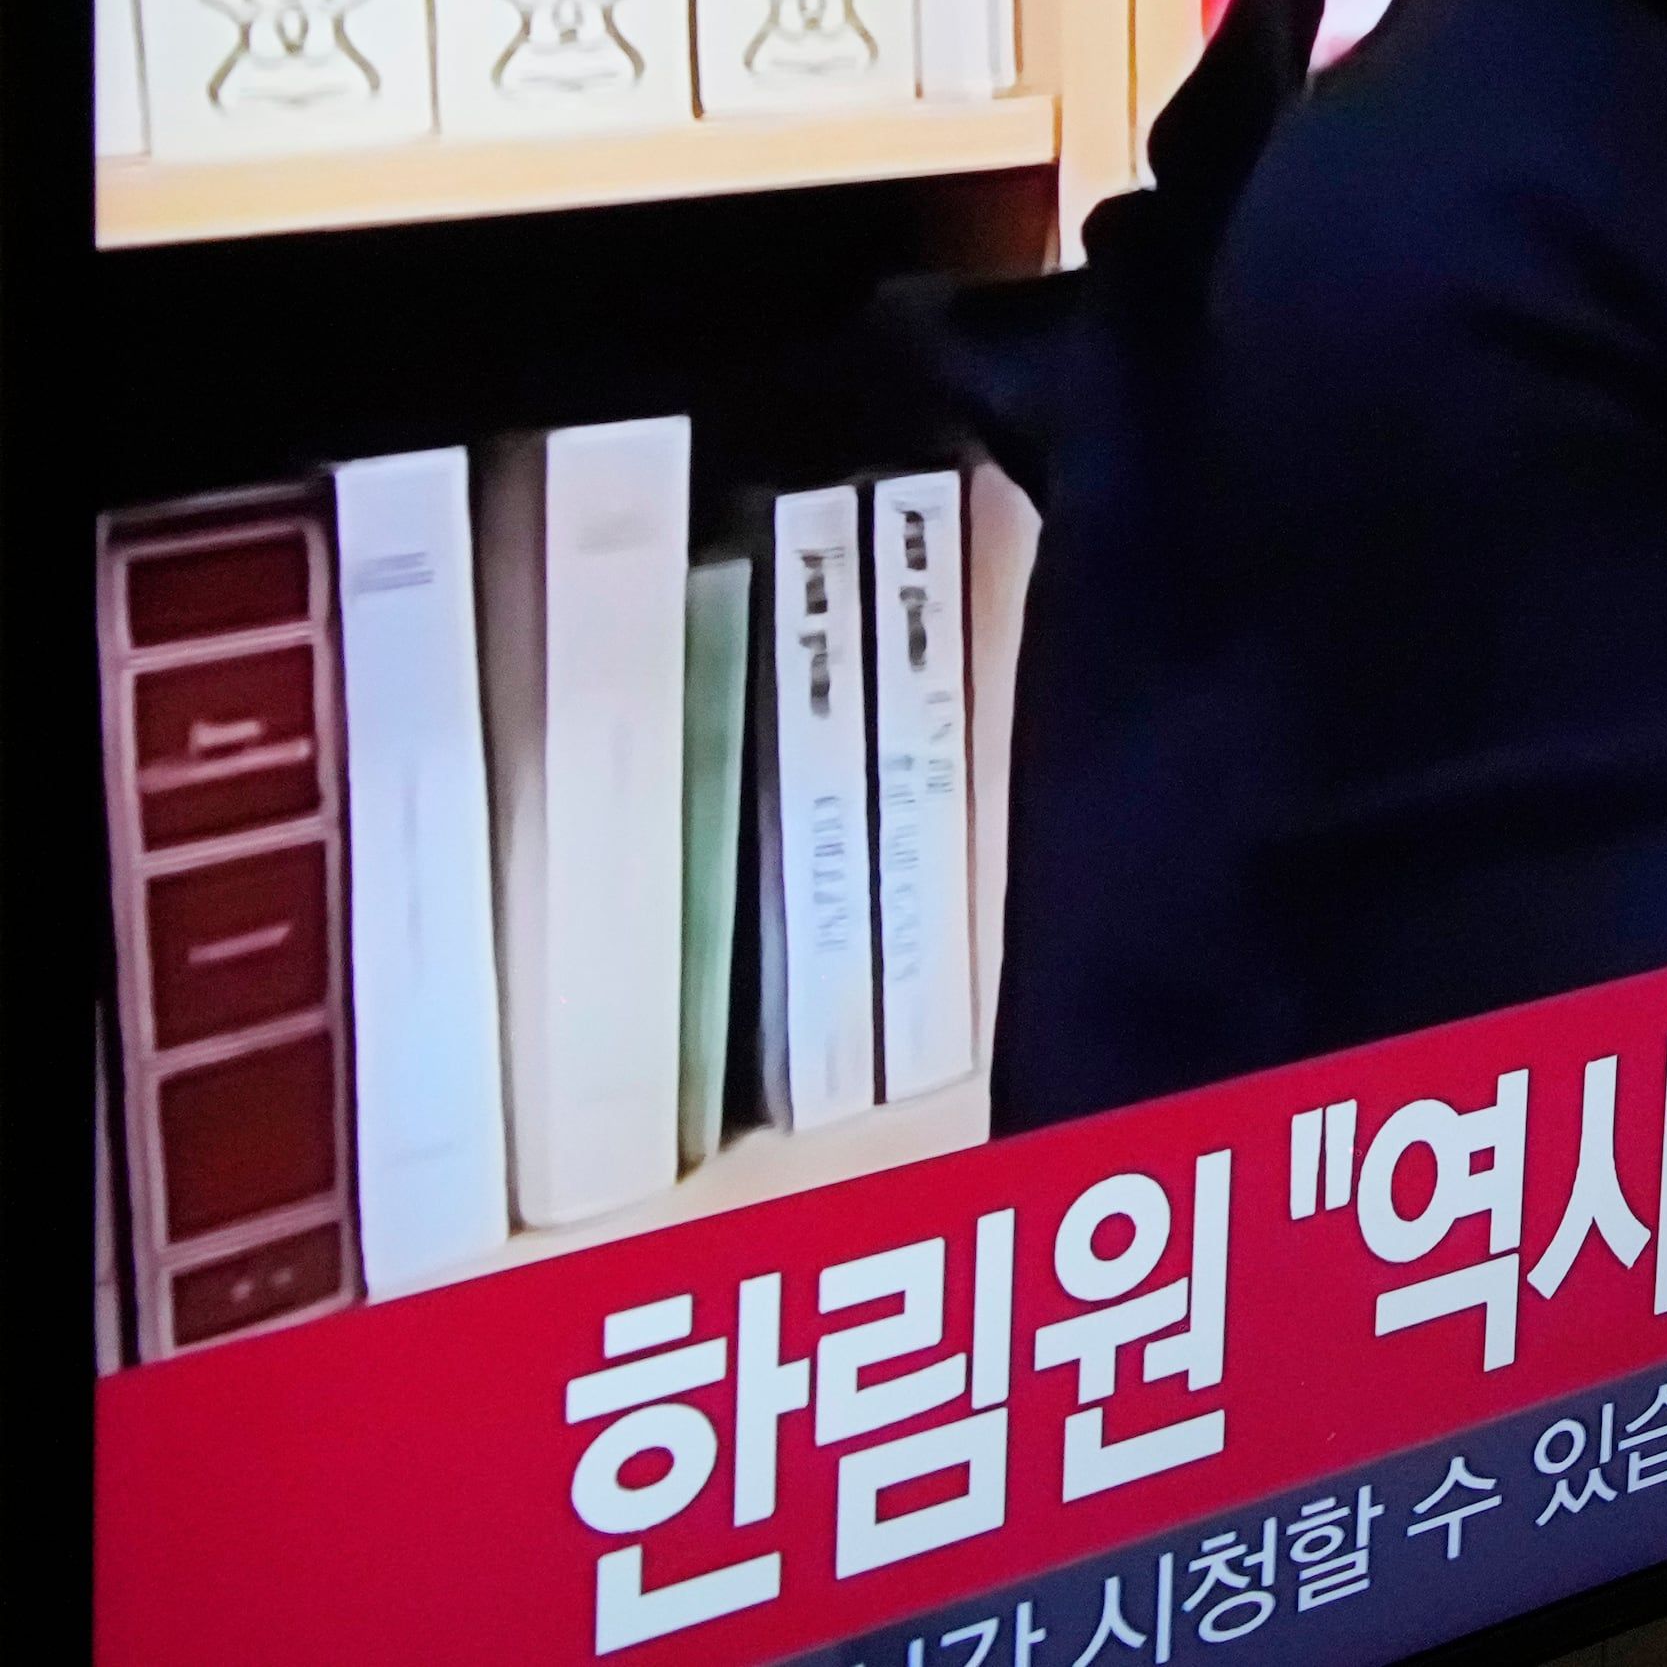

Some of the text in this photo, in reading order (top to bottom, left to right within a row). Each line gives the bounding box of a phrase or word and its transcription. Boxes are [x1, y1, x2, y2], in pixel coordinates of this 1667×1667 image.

[565, 1149, 1233, 1657] 한림원
[1076, 1484, 1386, 1666] 시청할
[1406, 1455, 1503, 1560] 수
